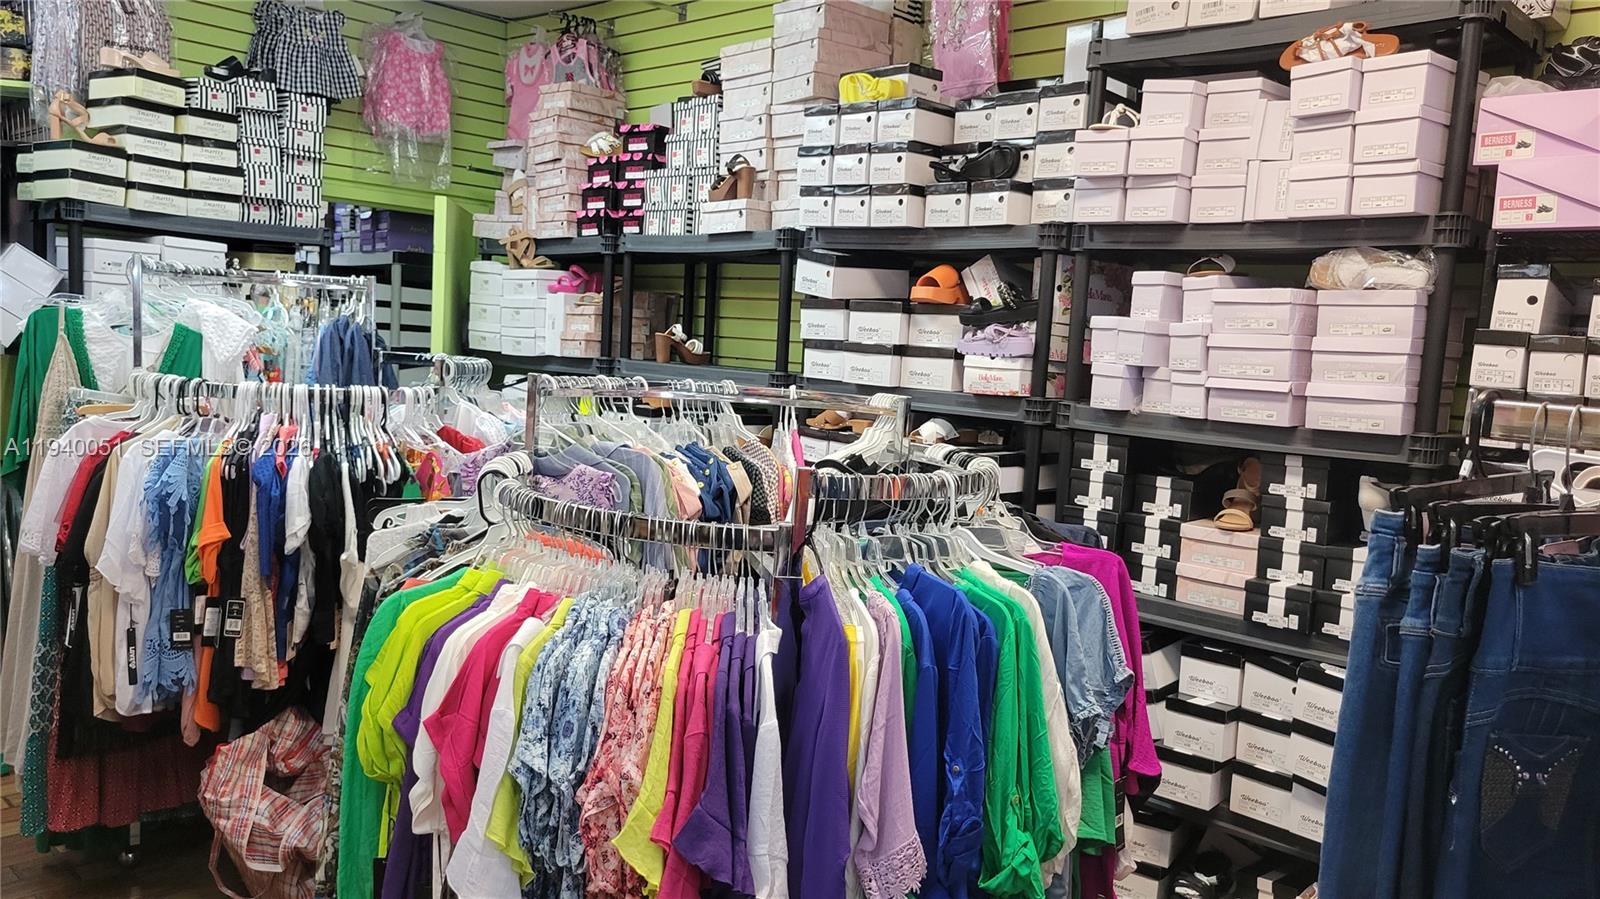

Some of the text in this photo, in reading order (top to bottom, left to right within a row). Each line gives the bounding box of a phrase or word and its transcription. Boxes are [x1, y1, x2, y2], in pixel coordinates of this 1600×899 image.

[1484, 135, 1513, 146] BERNESS
[1503, 199, 1533, 209] BERNESS
[1252, 691, 1280, 703] Weeboo
[1306, 701, 1335, 715] Weeboo
[1299, 754, 1326, 770] Weeboo
[1300, 815, 1324, 827] Weebo
